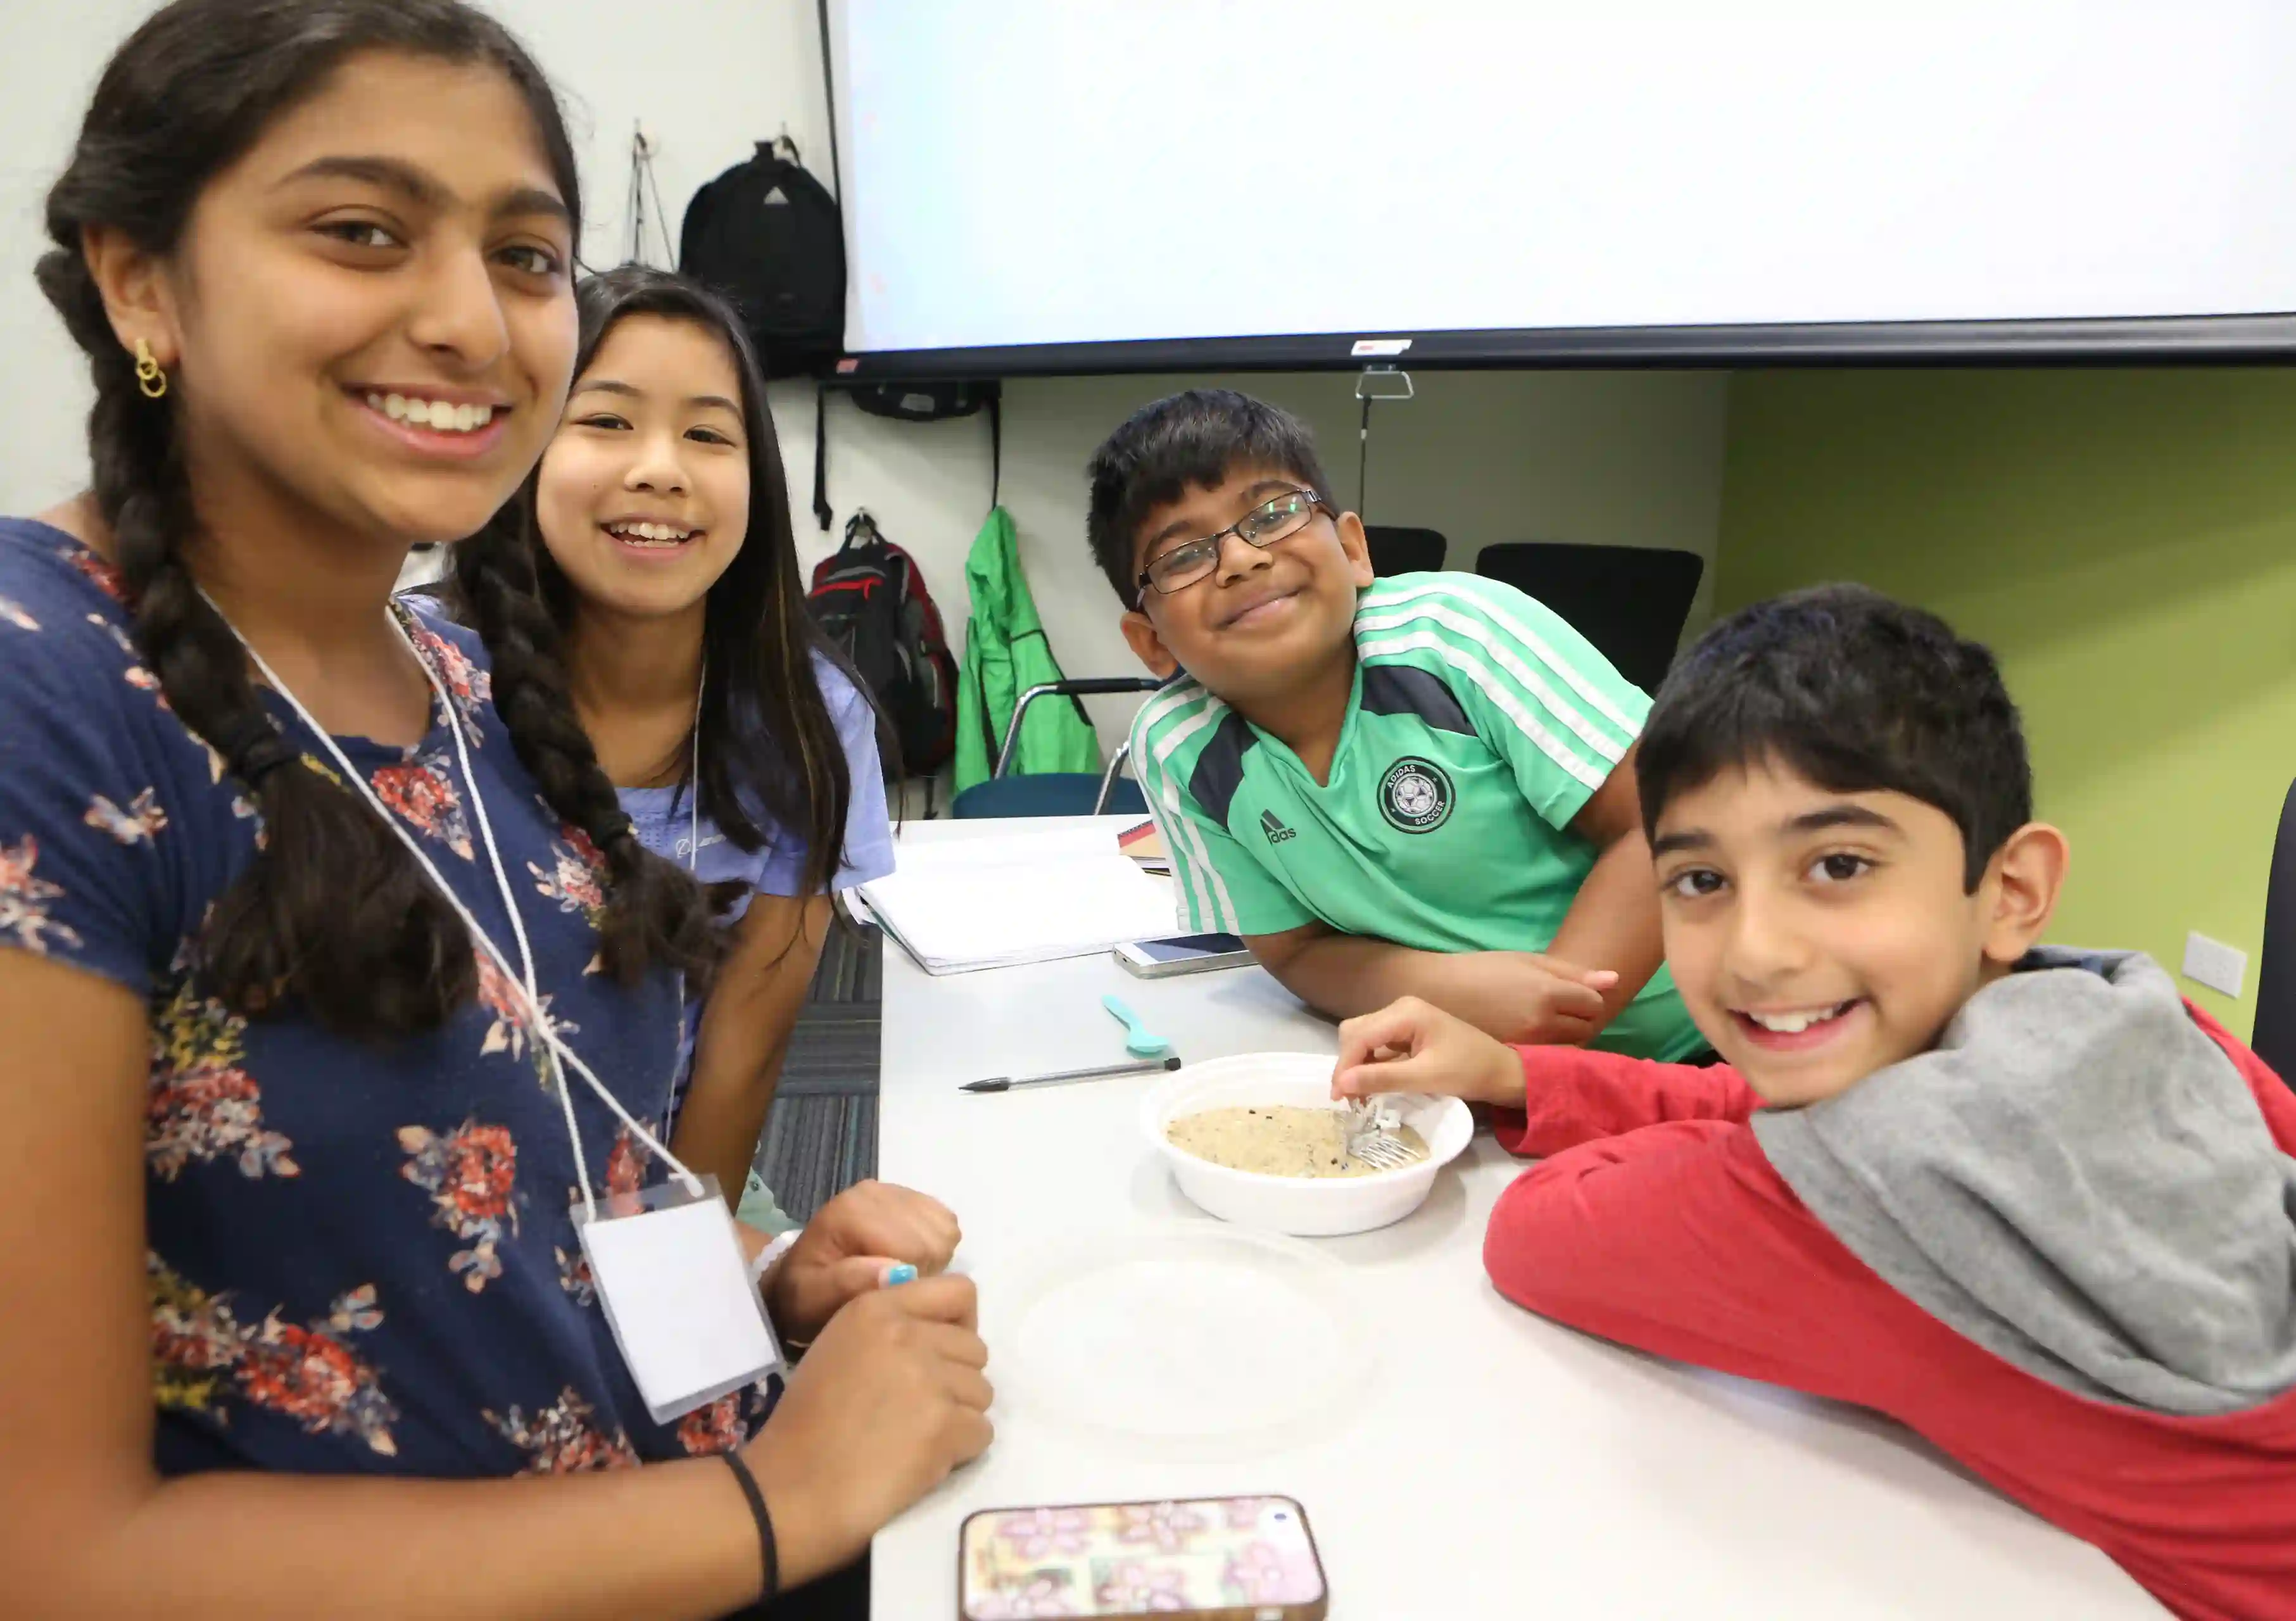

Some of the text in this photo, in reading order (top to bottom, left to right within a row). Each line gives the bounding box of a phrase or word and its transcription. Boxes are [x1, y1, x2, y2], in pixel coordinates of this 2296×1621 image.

[1387, 764, 1416, 788] ADIDAS
[1415, 800, 1445, 825] SOCCER
[1268, 828, 1296, 845] das
